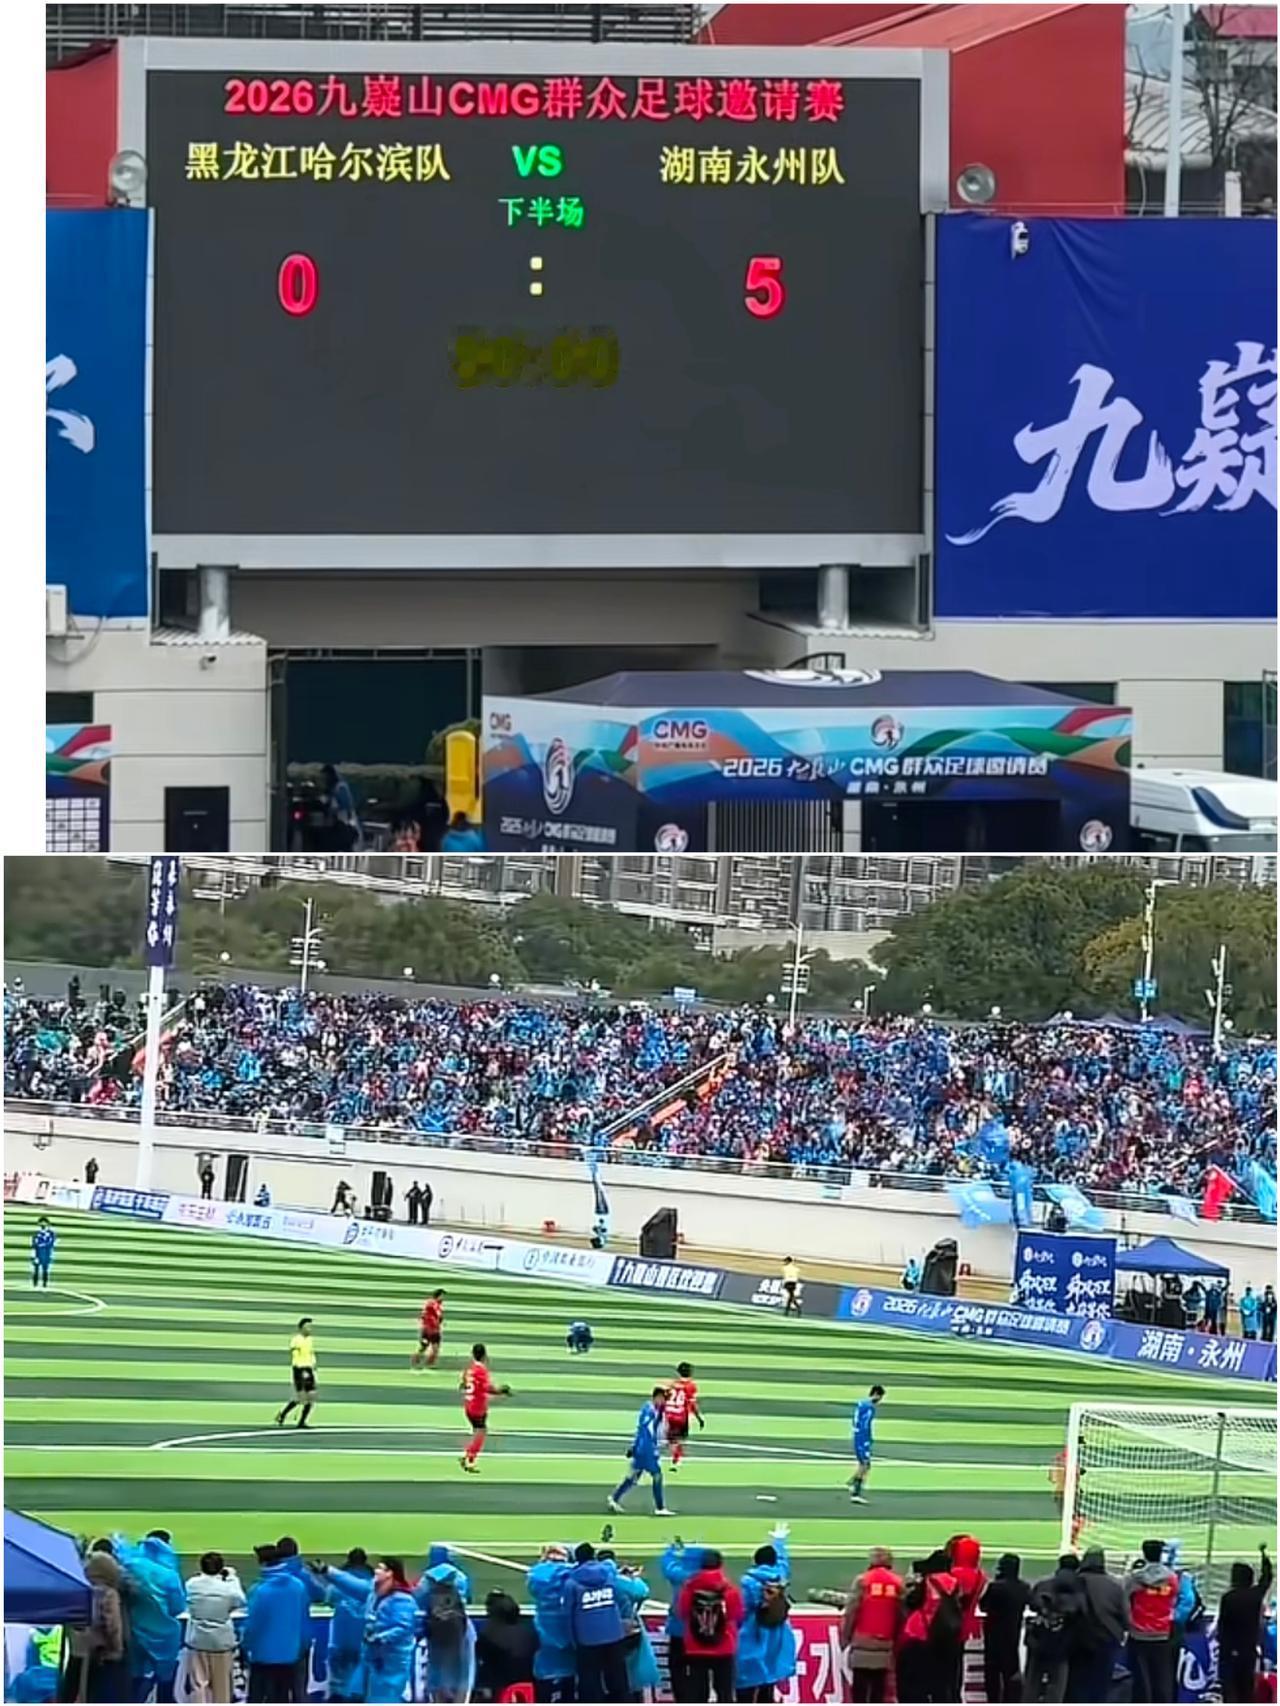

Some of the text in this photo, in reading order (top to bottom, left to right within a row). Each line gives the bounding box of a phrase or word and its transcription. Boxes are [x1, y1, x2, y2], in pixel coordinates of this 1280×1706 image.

[186, 142, 845, 186] 黑龙江哈尔滨队 VS 湖南永州队
[499, 197, 584, 228] 下半场
[279, 254, 317, 316] 0
[745, 258, 784, 317] 5
[653, 719, 707, 739] CMG
[1138, 1330, 1247, 1373] 湖南·永州
